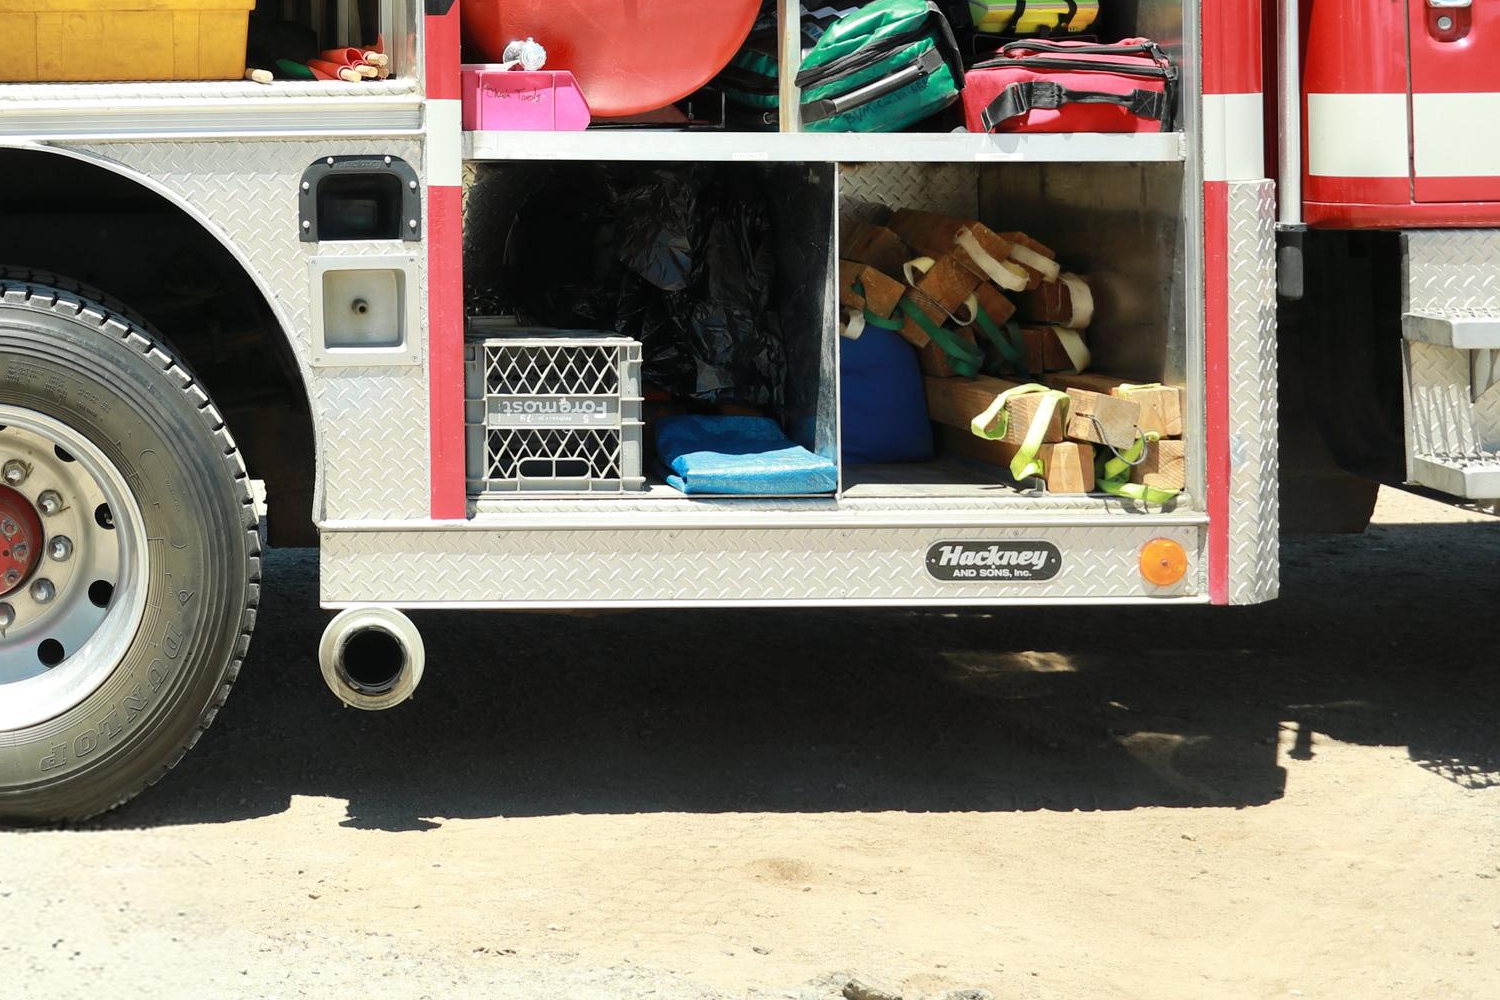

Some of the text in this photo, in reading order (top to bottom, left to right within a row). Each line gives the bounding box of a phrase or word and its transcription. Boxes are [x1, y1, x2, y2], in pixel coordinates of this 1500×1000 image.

[501, 399, 607, 419] Foremost
[938, 545, 1049, 570] Hackney
[952, 568, 1032, 578] AND SONS, Inc.
[38, 620, 186, 772] DUNLOP
